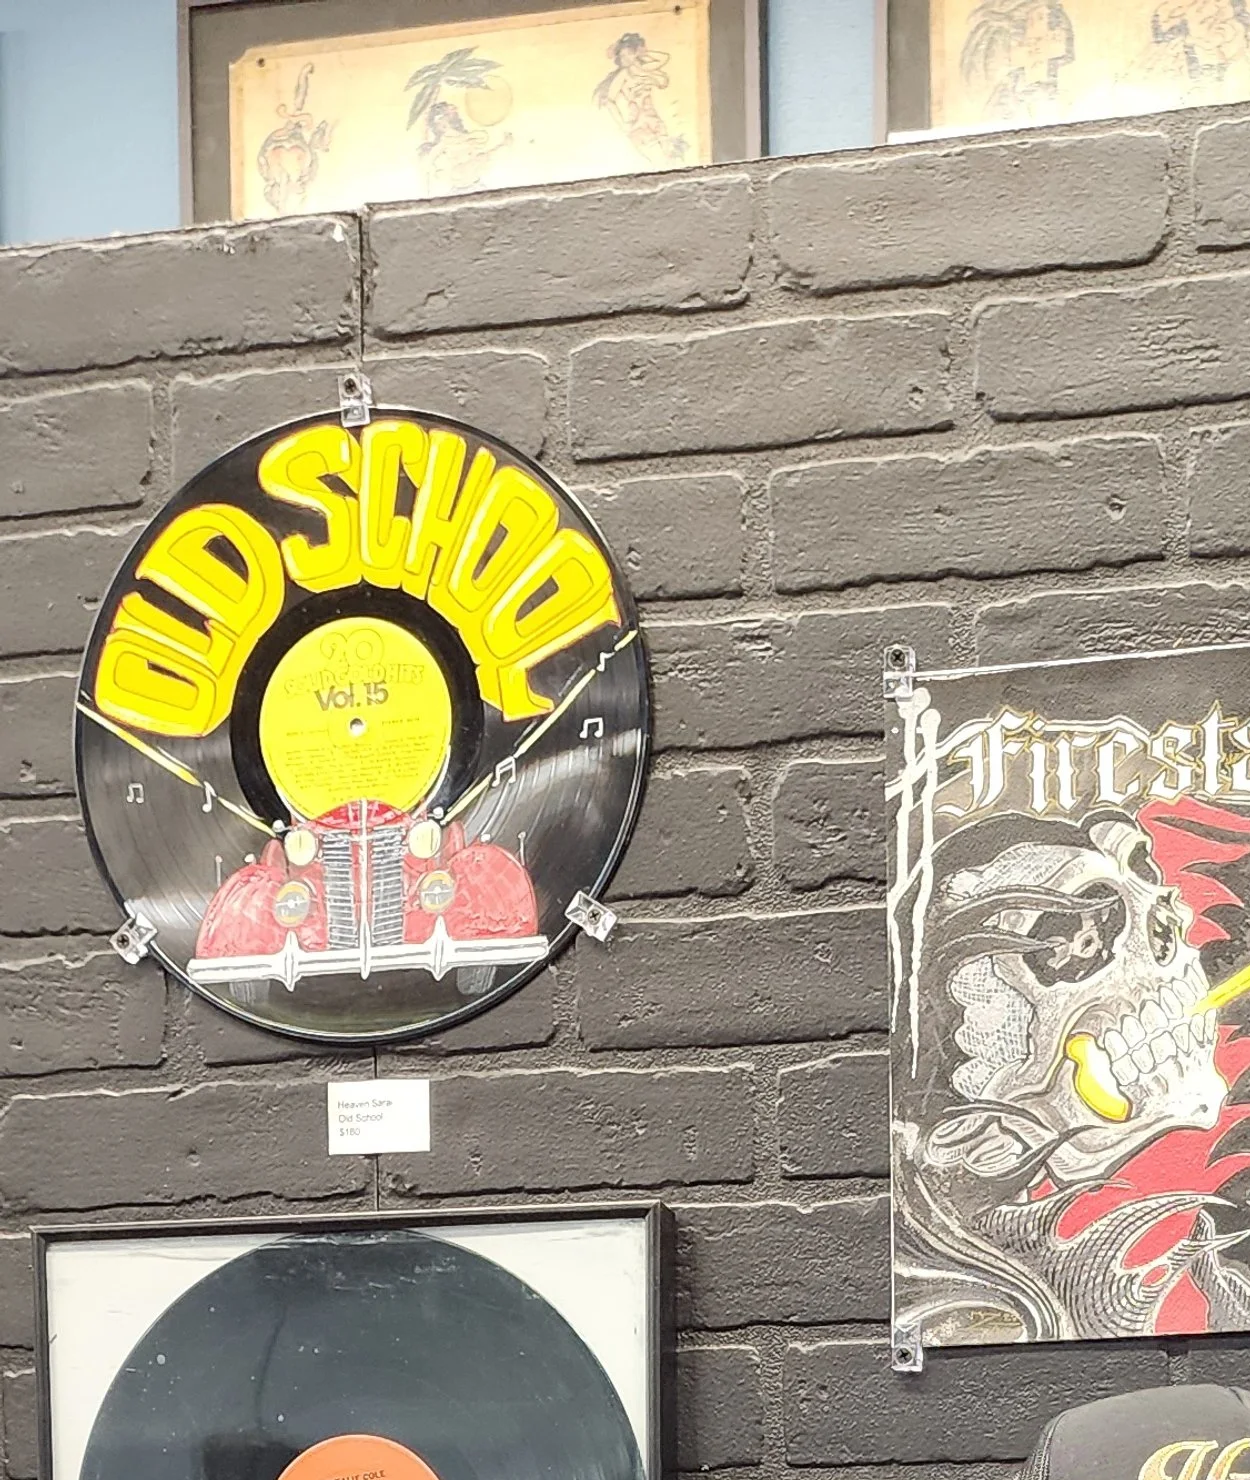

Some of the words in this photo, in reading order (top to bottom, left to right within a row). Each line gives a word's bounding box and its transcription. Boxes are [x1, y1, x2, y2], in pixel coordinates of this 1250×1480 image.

[94, 504, 284, 738] OLD
[258, 421, 621, 722] SCHOOL
[314, 681, 361, 711] Vol.
[365, 680, 389, 706] 15
[356, 1112, 384, 1123] School
[362, 1469, 386, 1480] COLE
